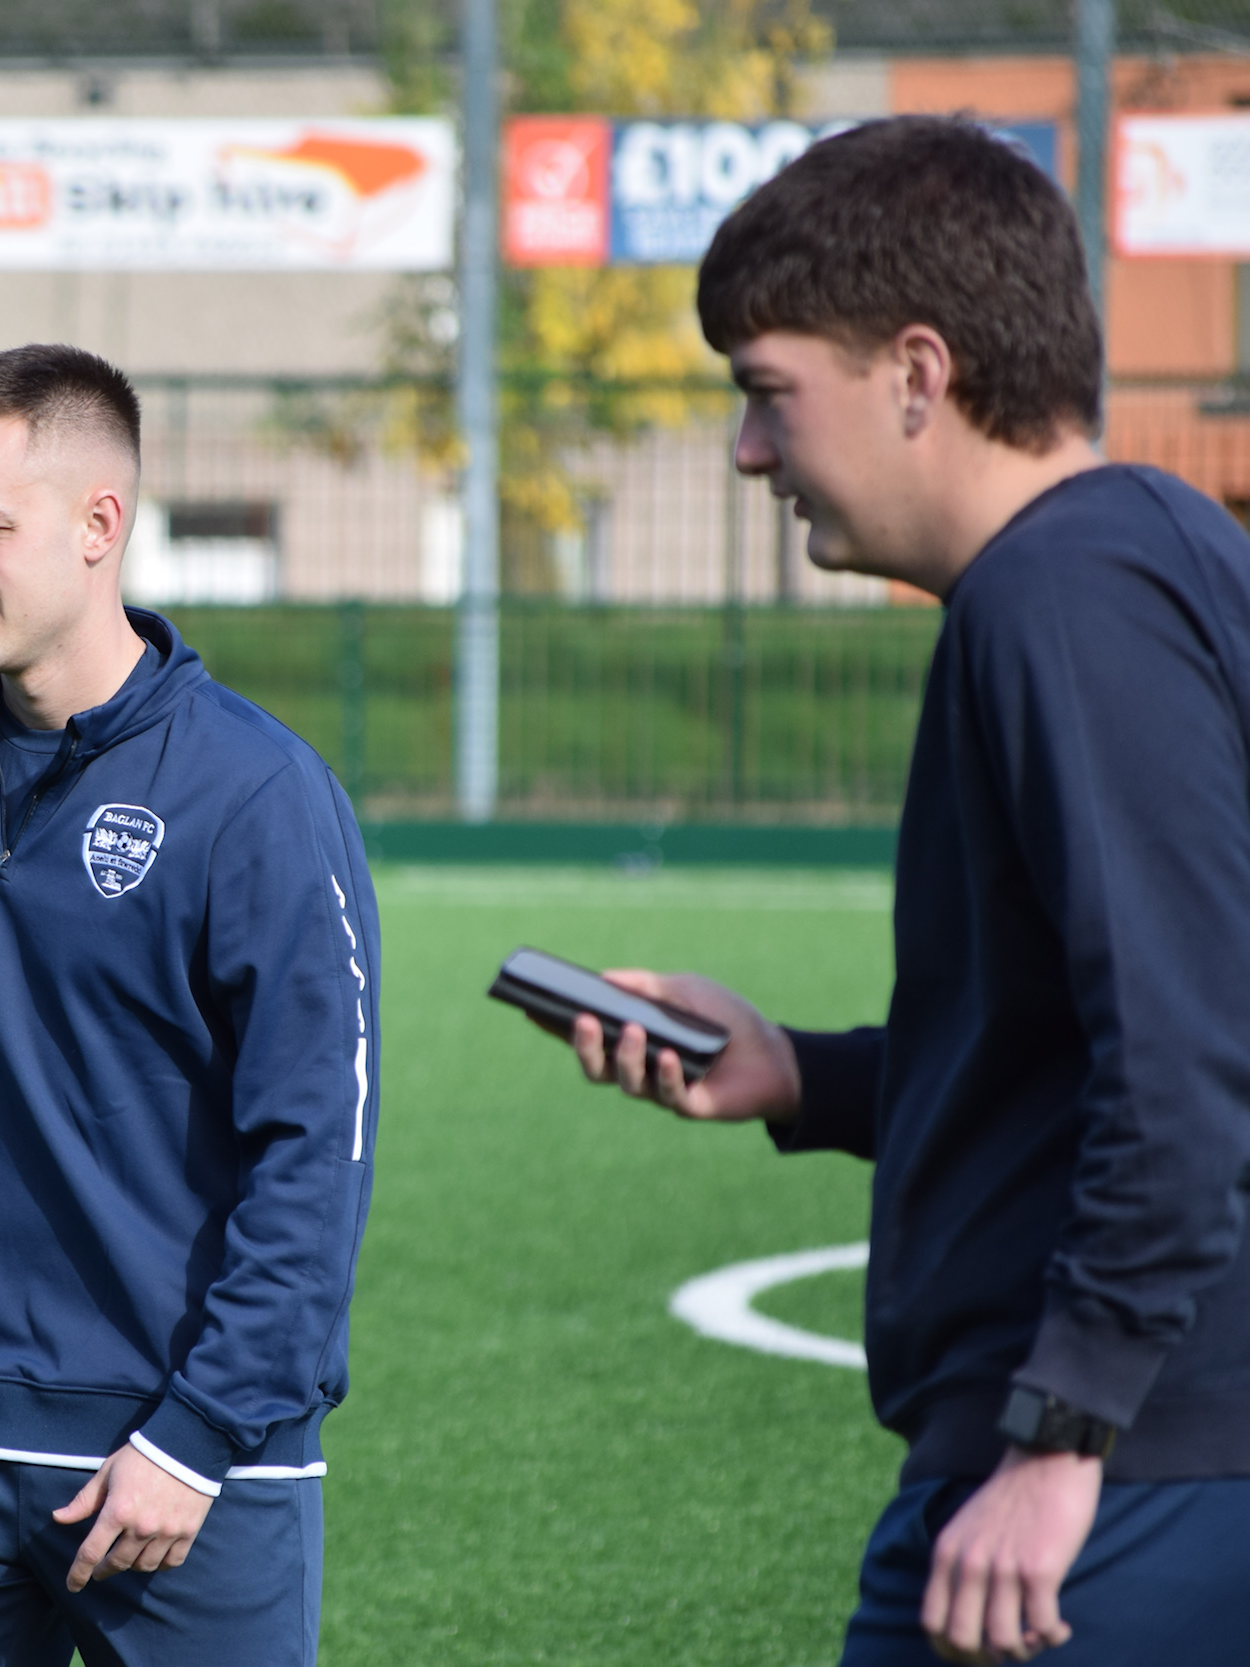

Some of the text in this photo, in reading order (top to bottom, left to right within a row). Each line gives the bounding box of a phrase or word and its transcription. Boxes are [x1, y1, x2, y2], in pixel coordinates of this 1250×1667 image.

[66, 174, 326, 226] Skip hire
[103, 811, 155, 834] BAGLAN FC
